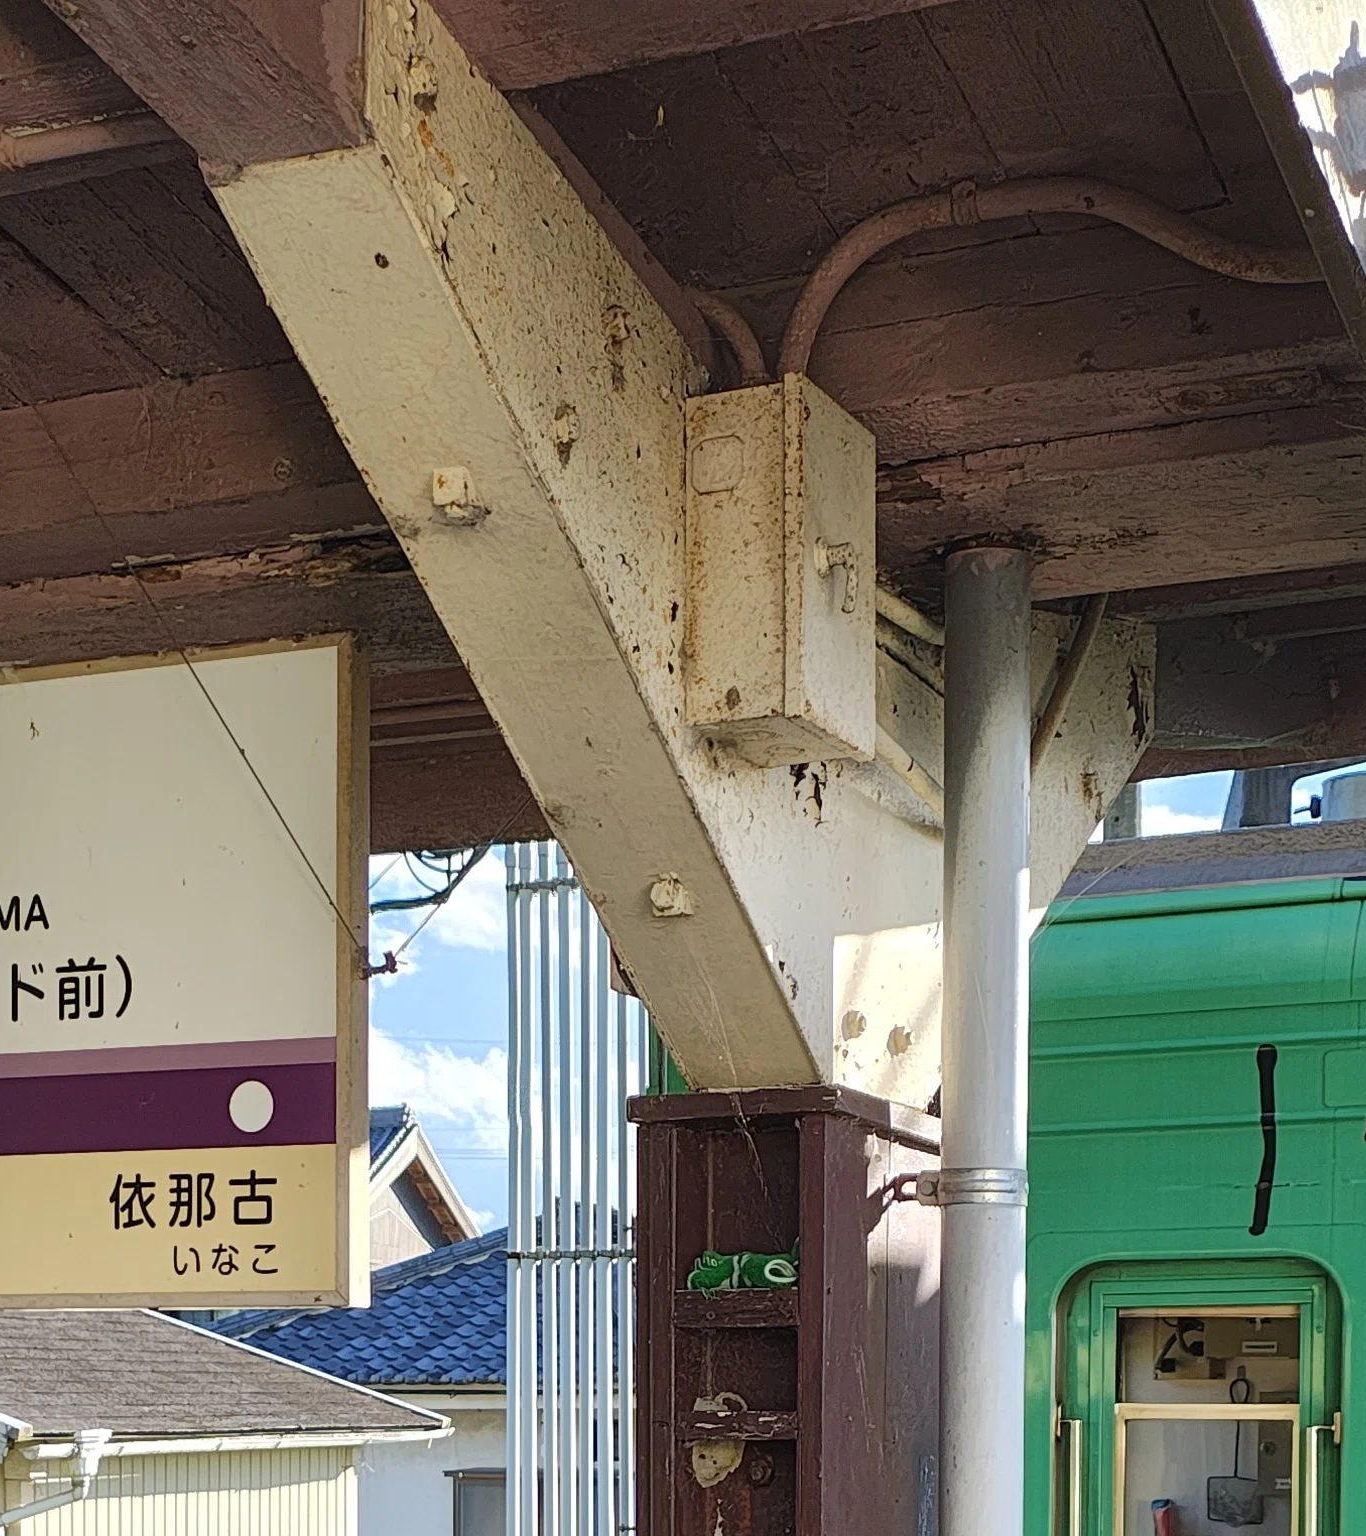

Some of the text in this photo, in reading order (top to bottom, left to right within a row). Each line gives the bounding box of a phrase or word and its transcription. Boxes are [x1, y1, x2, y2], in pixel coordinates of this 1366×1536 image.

[109, 1169, 278, 1230] 依那古
[173, 1243, 279, 1276] いなこ
